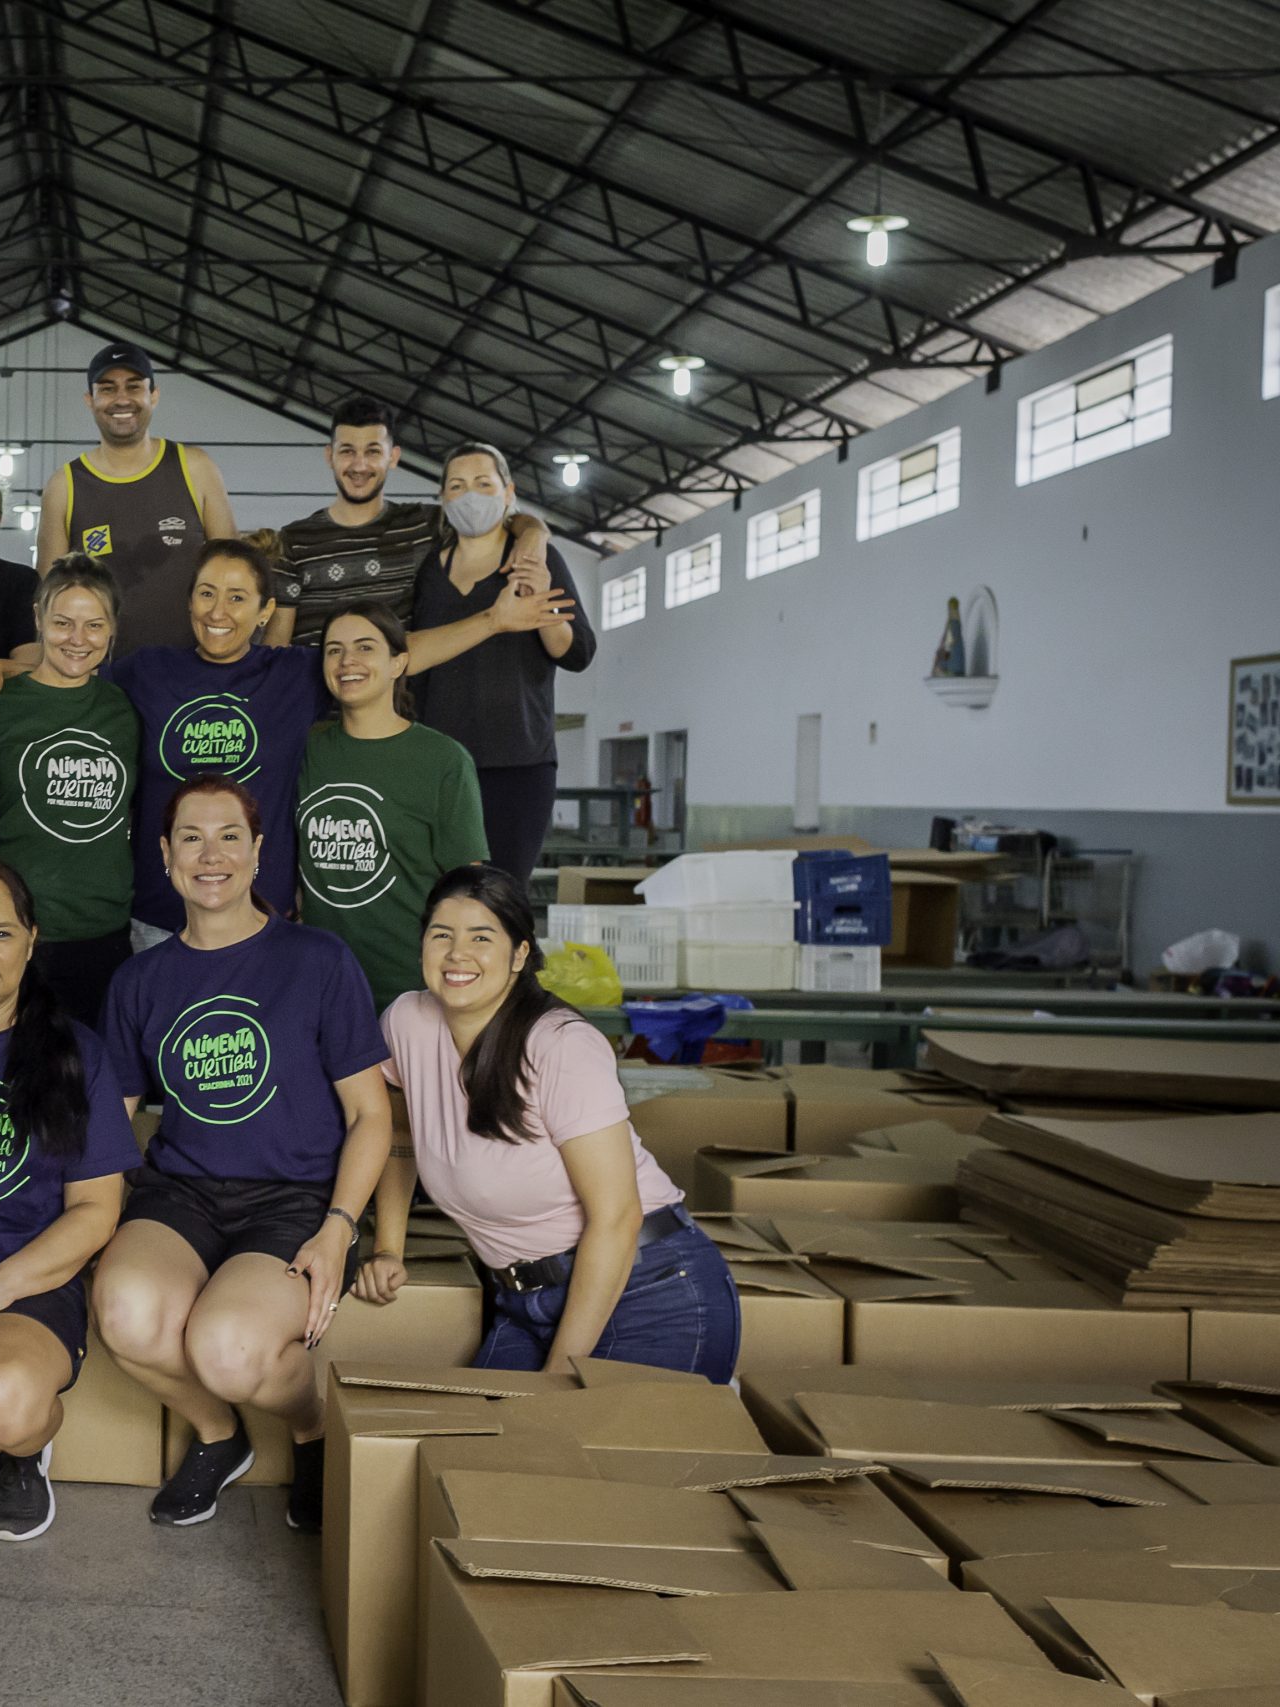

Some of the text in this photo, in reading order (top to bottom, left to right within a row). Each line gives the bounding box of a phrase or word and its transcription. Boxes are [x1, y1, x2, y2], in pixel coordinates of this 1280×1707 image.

[93, 798, 112, 810] 2020
[355, 859, 375, 871] 2020
[236, 1074, 253, 1086] 2021
